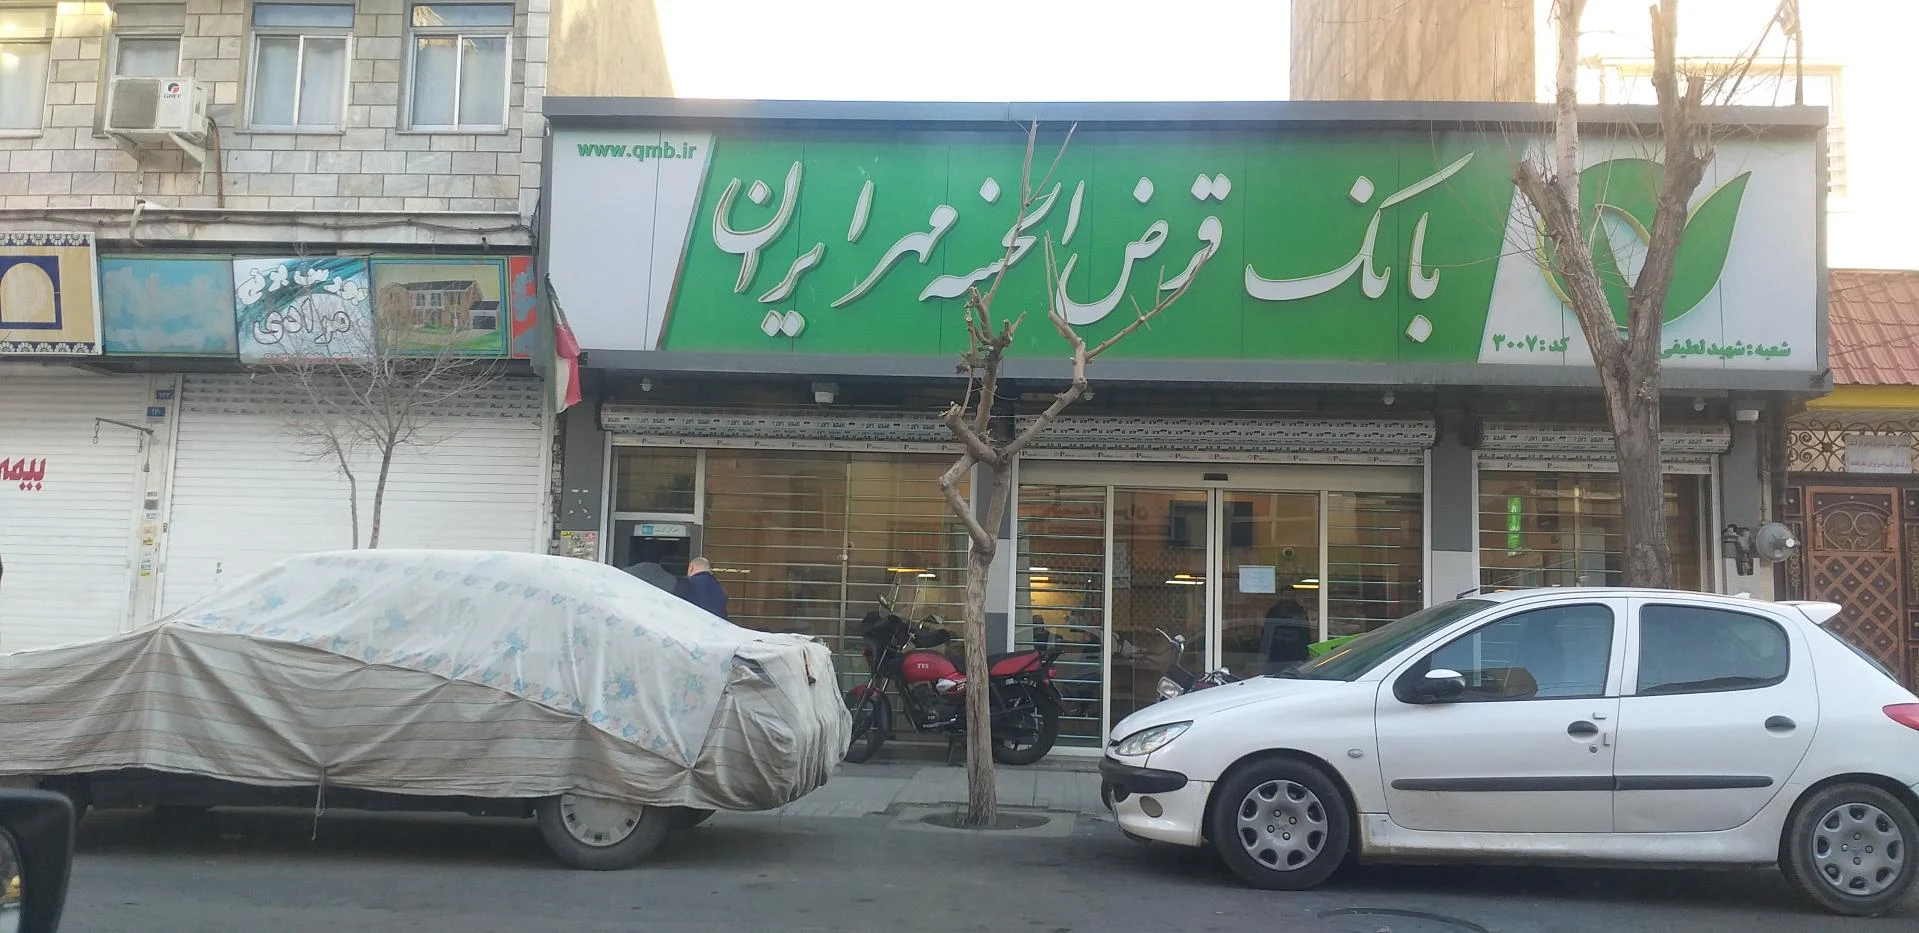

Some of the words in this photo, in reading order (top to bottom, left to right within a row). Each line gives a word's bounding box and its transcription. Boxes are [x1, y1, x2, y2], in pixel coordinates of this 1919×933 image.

[576, 141, 697, 162] www.qmb.ir
[711, 160, 875, 338] ایران
[830, 204, 959, 309] مهر
[1055, 173, 1232, 326] قرض
[1244, 151, 1475, 344] بانک
[252, 297, 350, 345] مرادی
